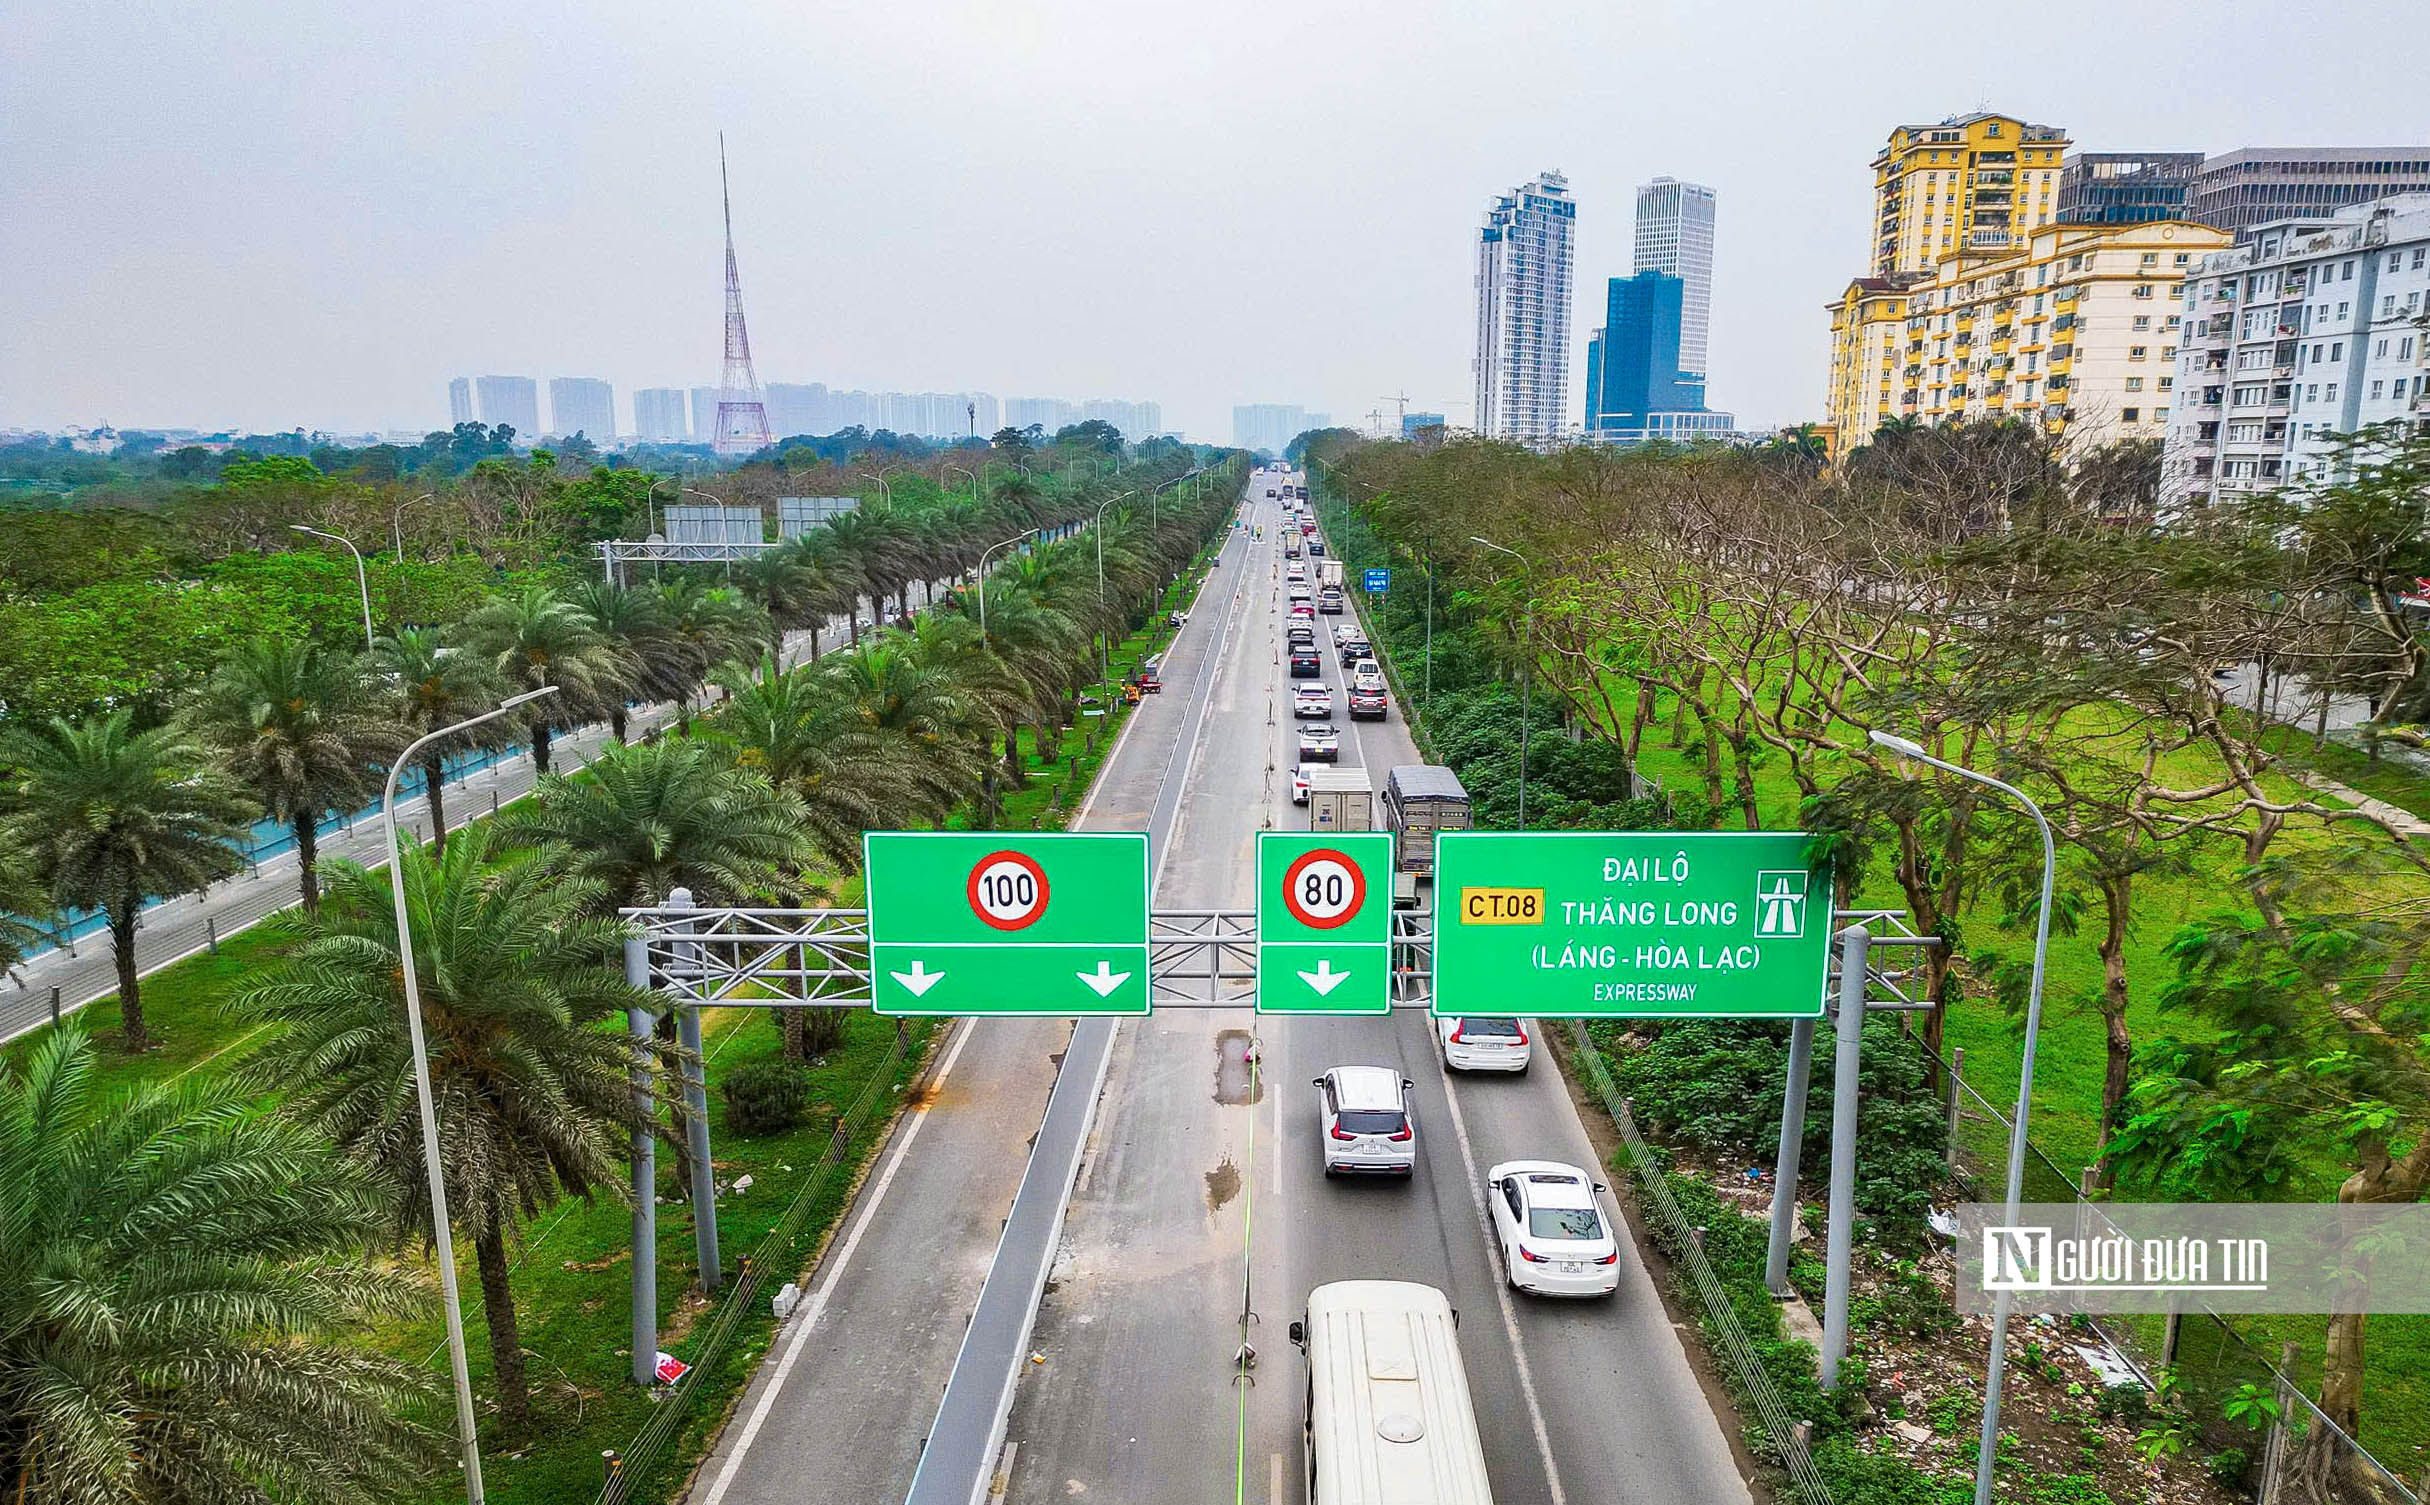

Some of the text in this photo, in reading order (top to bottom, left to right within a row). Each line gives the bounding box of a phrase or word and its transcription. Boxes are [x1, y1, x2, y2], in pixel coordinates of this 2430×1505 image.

[1603, 850, 1689, 887] ĐẠI LỘ
[983, 873, 1034, 908] 100
[1305, 873, 1343, 907] 80
[1469, 895, 1536, 918] CT.08
[1560, 896, 1737, 926] THĂNG LONG
[1532, 939, 1616, 969] (LÁNG
[1635, 939, 1690, 968] HÒA
[1698, 945, 1760, 975] LẠC)
[1593, 983, 1697, 1001] EXPRESSWAY
